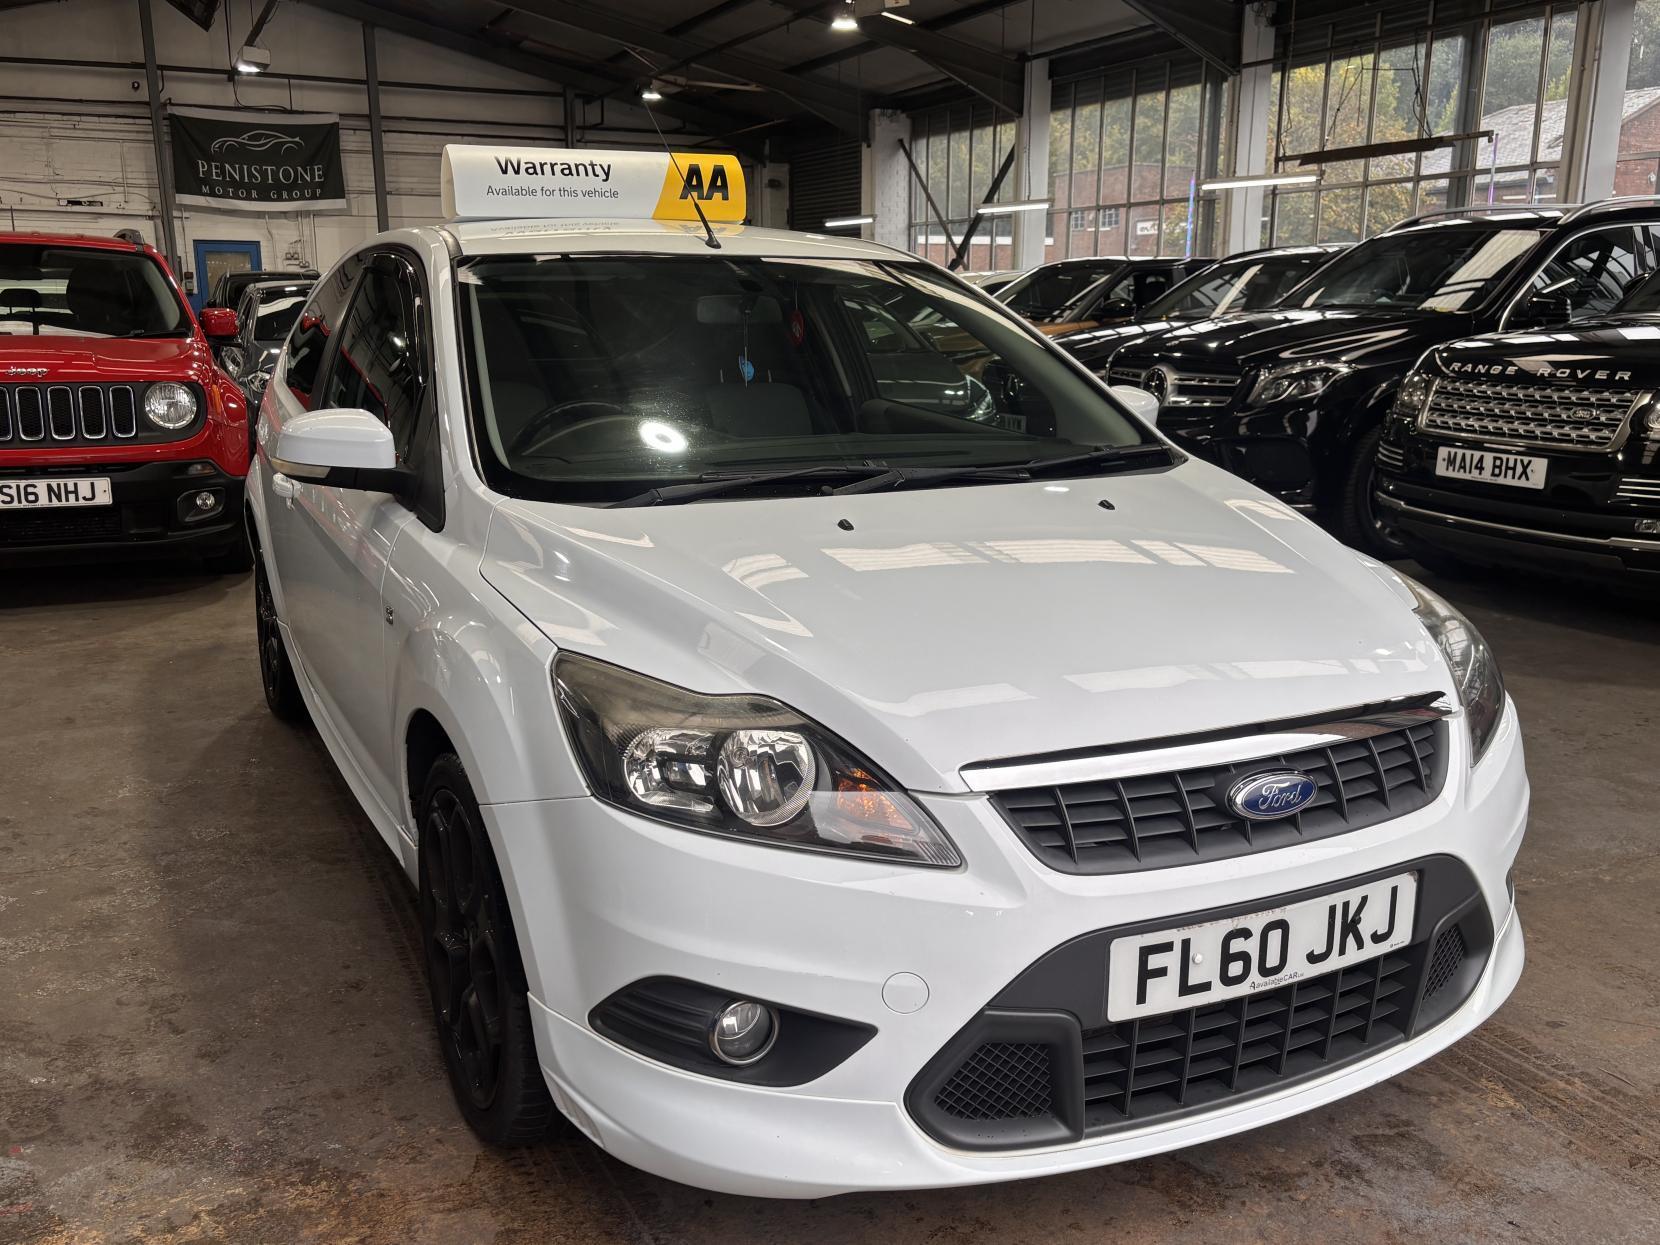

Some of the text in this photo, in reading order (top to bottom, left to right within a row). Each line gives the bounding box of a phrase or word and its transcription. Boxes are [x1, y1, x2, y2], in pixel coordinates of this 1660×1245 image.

[197, 159, 325, 184] PENISTONE
[494, 156, 612, 182] Warranty
[201, 185, 321, 199] MOTOR GROUP
[486, 185, 619, 199] Available for this vehicle
[679, 164, 729, 201] AA
[1450, 362, 1632, 381] RANGE ROVER
[1445, 451, 1533, 481] MA14 BHX
[46, 481, 97, 503] NHJ
[1258, 781, 1302, 810] Ford
[1136, 885, 1399, 1006] FL60 JKJ
